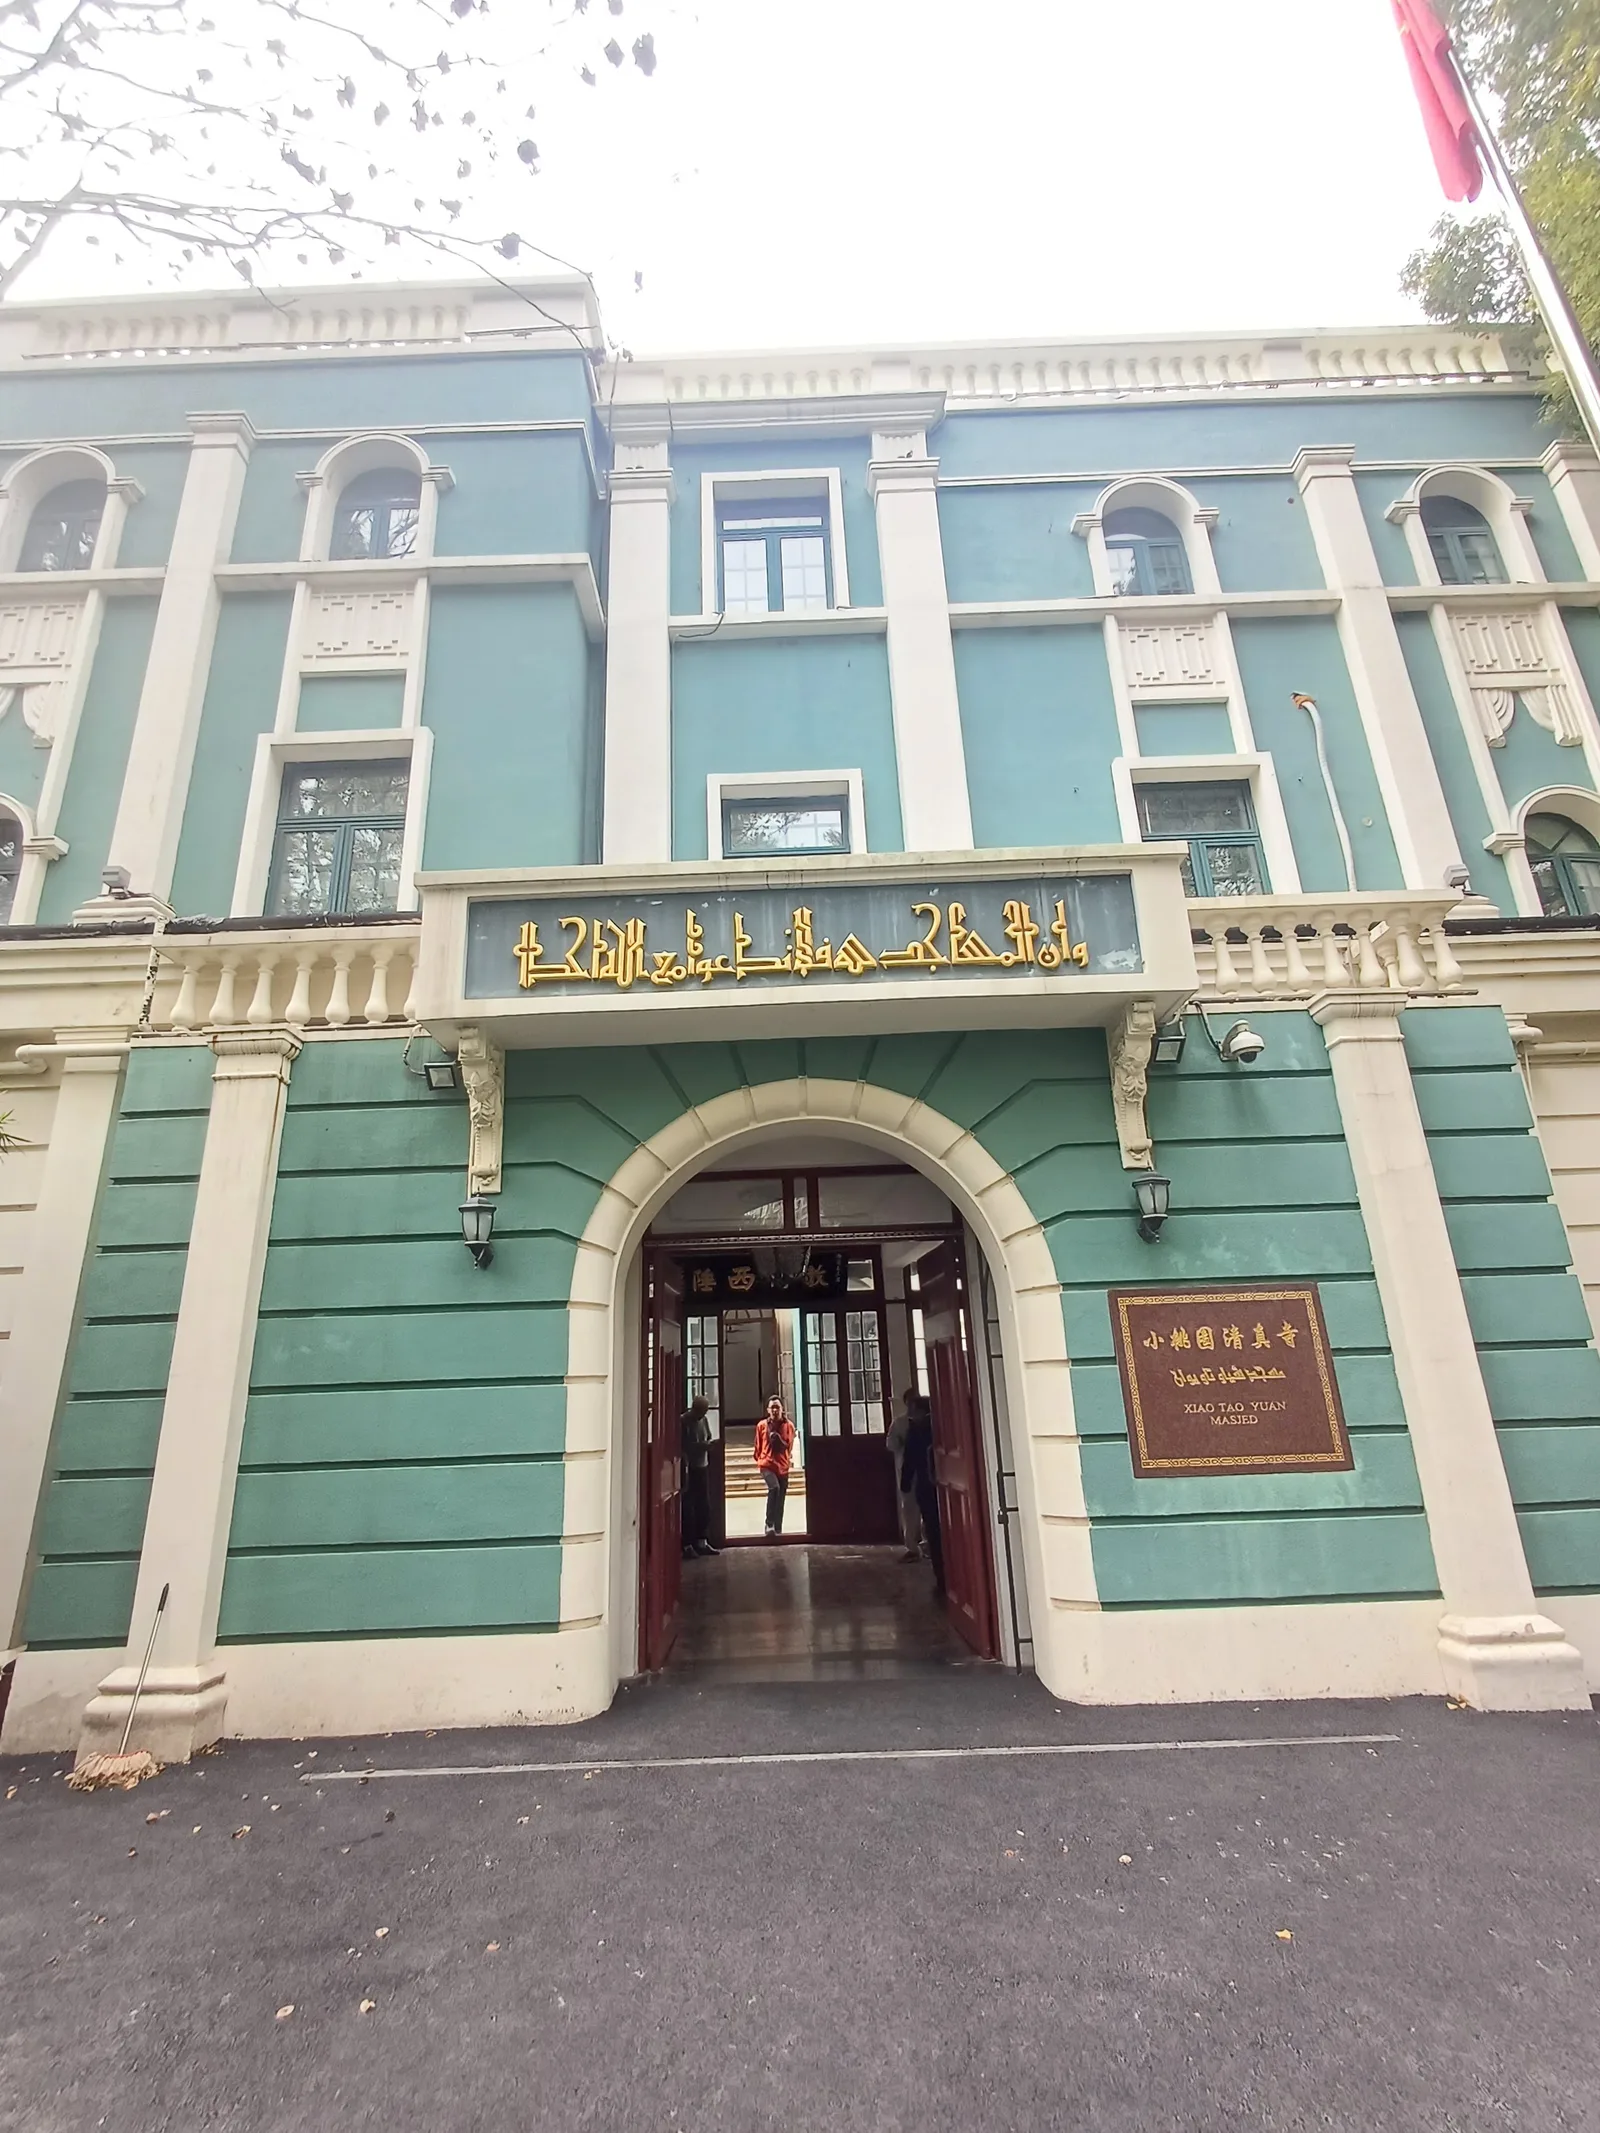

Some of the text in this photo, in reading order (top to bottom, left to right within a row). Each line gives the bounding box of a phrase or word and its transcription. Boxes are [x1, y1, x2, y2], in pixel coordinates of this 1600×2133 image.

[1183, 1401, 1287, 1414] XIAO TAO YUAN
[1209, 1414, 1258, 1425] MASJED
